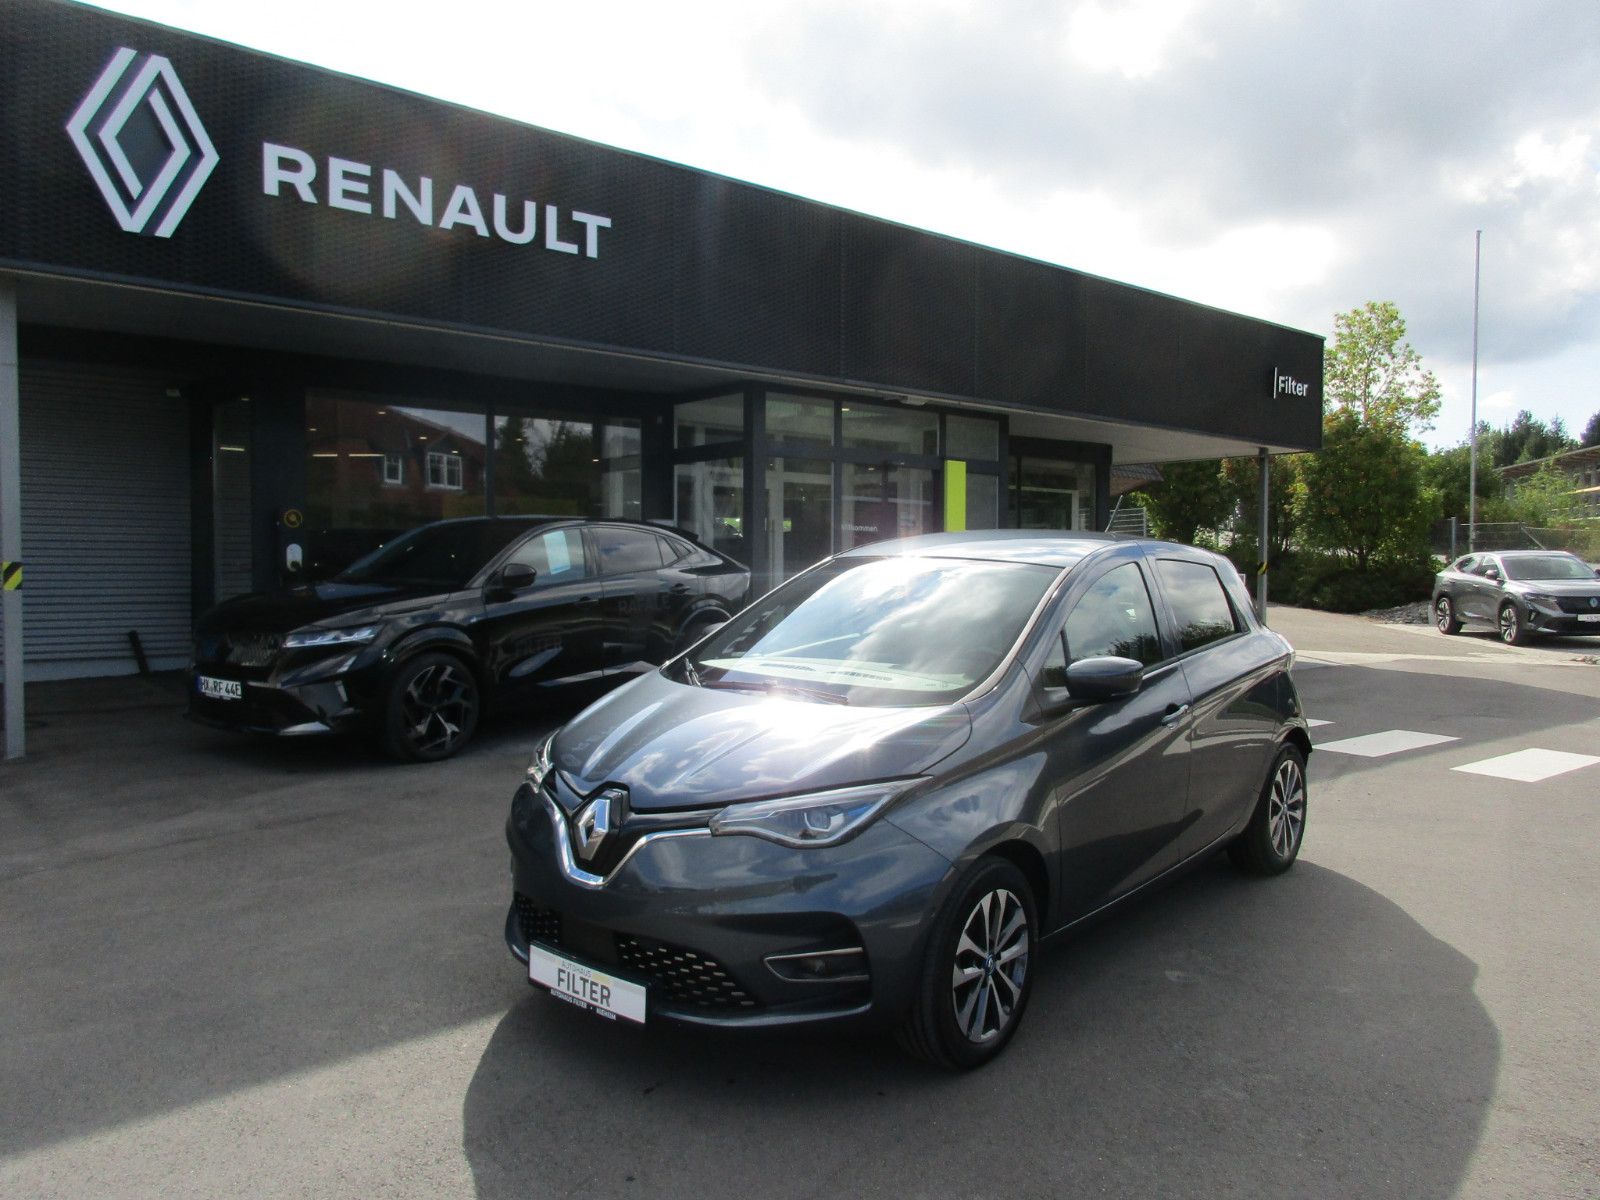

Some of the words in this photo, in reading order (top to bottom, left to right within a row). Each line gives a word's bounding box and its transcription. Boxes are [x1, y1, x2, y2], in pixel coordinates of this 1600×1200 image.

[263, 142, 611, 258] RENAULT
[1278, 376, 1308, 397] Filter
[225, 682, 241, 697] 44E
[557, 968, 611, 1007] FILTER
